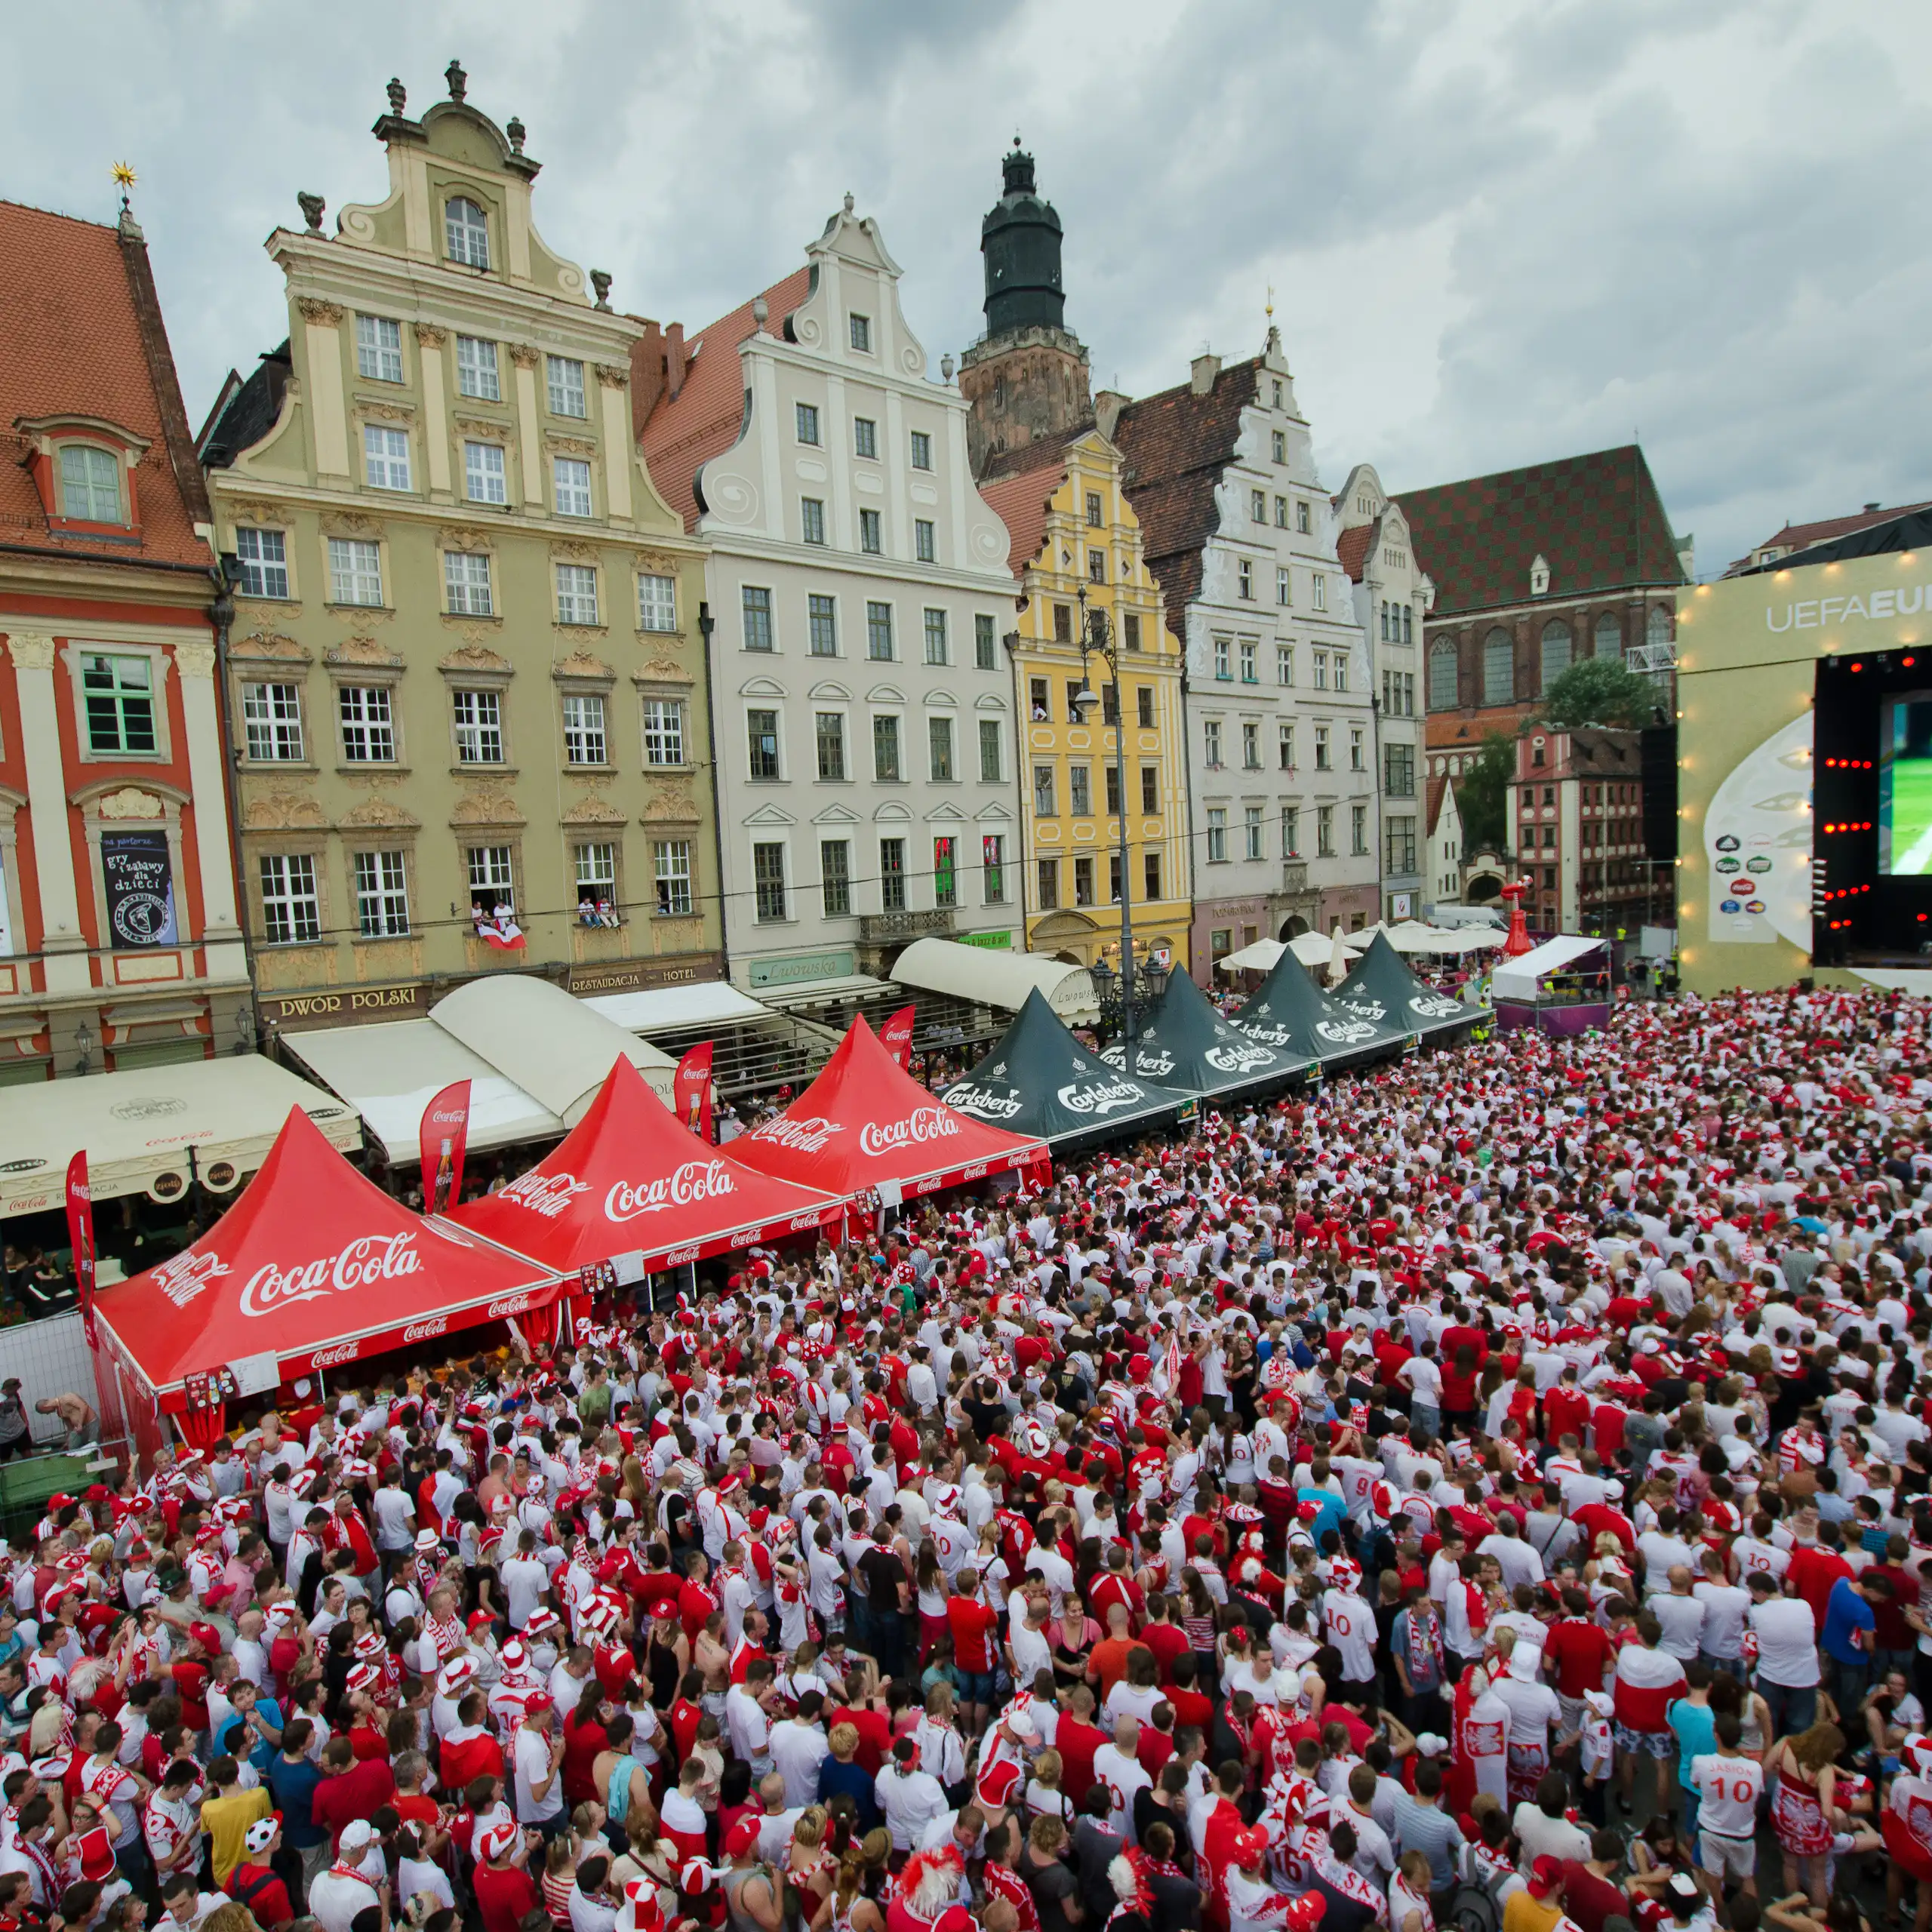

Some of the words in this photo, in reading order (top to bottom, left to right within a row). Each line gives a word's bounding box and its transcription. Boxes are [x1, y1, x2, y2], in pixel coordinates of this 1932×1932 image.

[107, 854, 128, 869] gry
[119, 862, 125, 872] i
[126, 860, 164, 874] zabawy
[115, 878, 159, 891] dzieci
[134, 872, 149, 880] dla
[770, 957, 836, 979] Lwowska
[572, 975, 639, 992] RESTAURACJA
[663, 969, 696, 981] HOTEL
[351, 988, 415, 1009] POLSKI
[1409, 993, 1464, 1017] Carlsberg
[1316, 1015, 1378, 1044] Carlsberg
[1205, 1040, 1278, 1073] Carlsberg
[942, 1083, 1023, 1118] Carlsberg
[1057, 1075, 1146, 1114] Carlsberg
[860, 1107, 958, 1156] Coca-Cola
[605, 1159, 735, 1222] Coca-Cola
[667, 1245, 700, 1266] Coca-Cola
[240, 1232, 420, 1317] Coca-Cola
[488, 1294, 528, 1318] Coca-Cola
[404, 1316, 448, 1342] Coca-Cola
[311, 1340, 359, 1368] Coca-Cola
[1356, 1477, 1368, 1497] 9
[1406, 1506, 1428, 1517] POLSKA
[1748, 1553, 1770, 1571] 10
[1326, 1607, 1352, 1637] 10
[1710, 1777, 1752, 1803] 10
